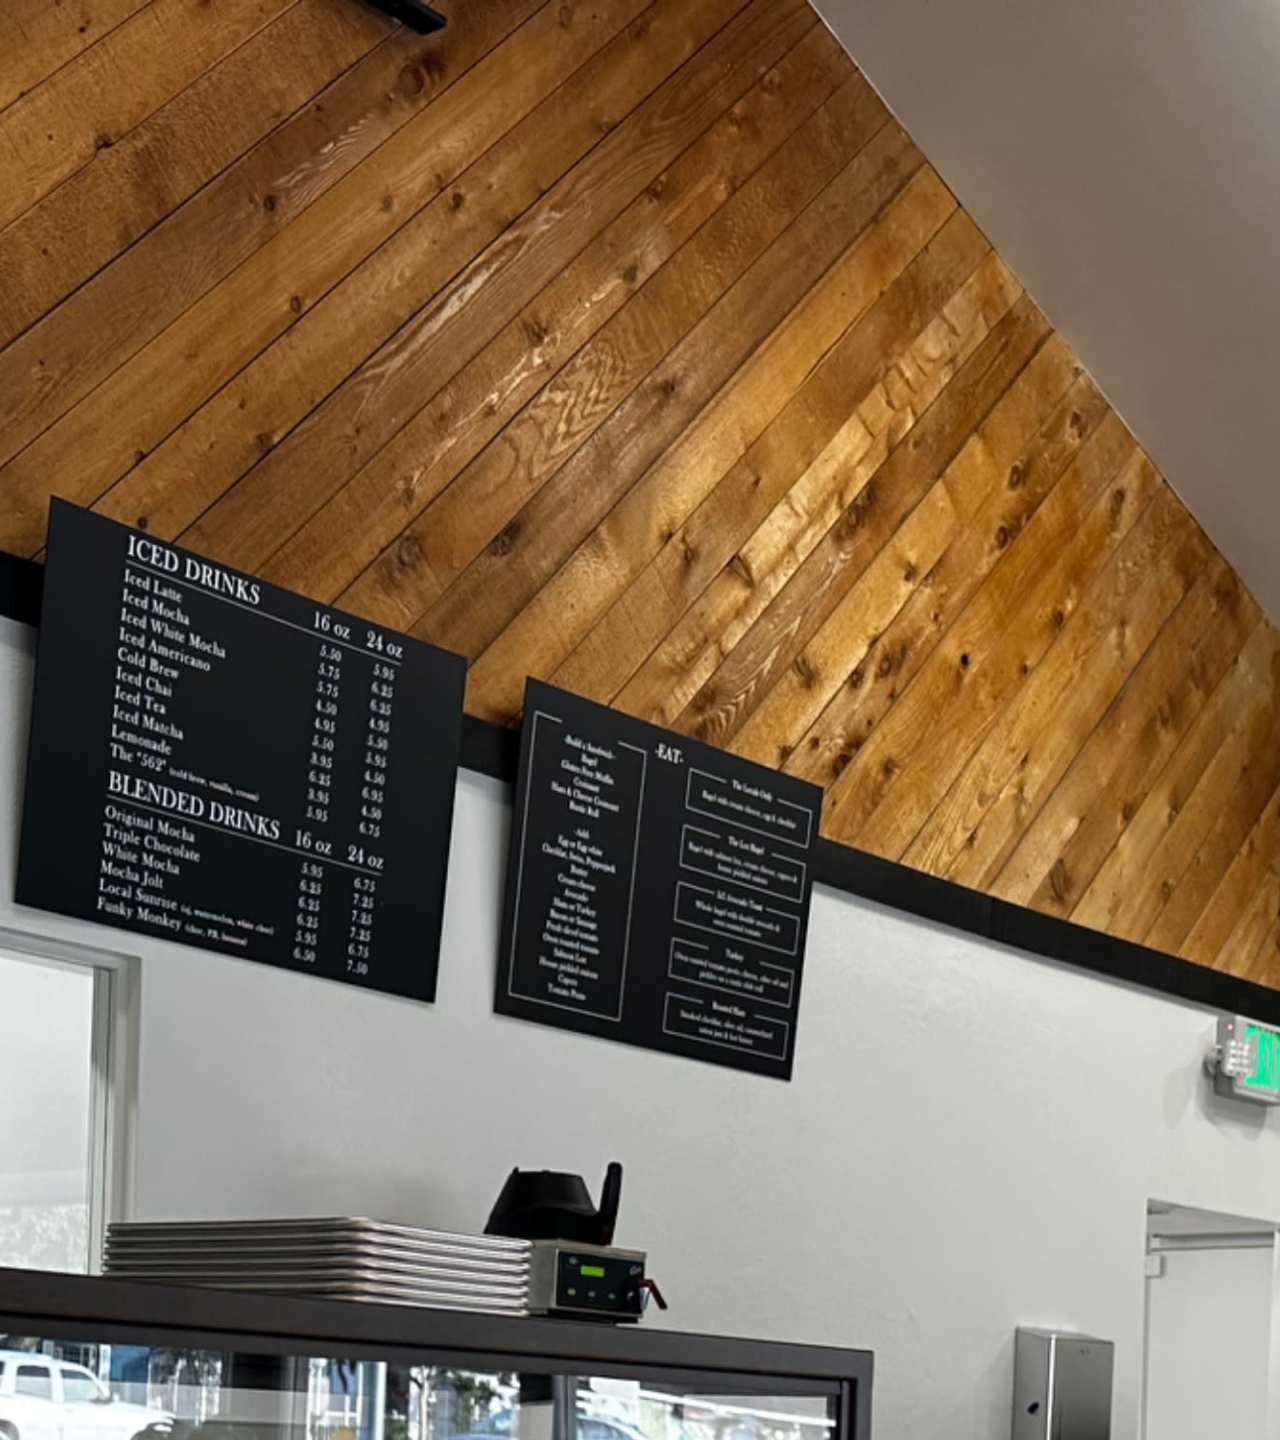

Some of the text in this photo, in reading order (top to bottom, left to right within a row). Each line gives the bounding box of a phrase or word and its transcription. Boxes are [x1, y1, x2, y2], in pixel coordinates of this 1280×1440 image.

[124, 568, 182, 603] Iced Latte
[128, 534, 260, 605] ICED DRINKS
[122, 588, 190, 626] Iced Mocha
[121, 607, 226, 659] Iced White Mocha
[314, 611, 350, 640] 16 oz
[119, 626, 211, 672] Iced Americano
[366, 630, 403, 659] 24 oz
[117, 646, 179, 679] Cold Brew
[116, 665, 172, 697] Iced Chai
[114, 684, 166, 715] Iced Tea
[113, 704, 184, 740] Iced Matcha
[110, 742, 133, 762] The
[111, 723, 172, 756] Lemonade
[109, 770, 205, 817] BLENDED
[209, 801, 280, 840] DRINKS
[104, 805, 195, 843] Original Mocha
[102, 840, 180, 875] White Mocha
[103, 822, 200, 863] Triple Chocolate
[295, 829, 332, 855] 16 oz
[347, 845, 384, 869] 24 oz
[100, 859, 163, 889] Mocha Jolt
[99, 877, 178, 911] Local Sunrise
[97, 895, 133, 919] Funky
[137, 906, 181, 931] Monkey
